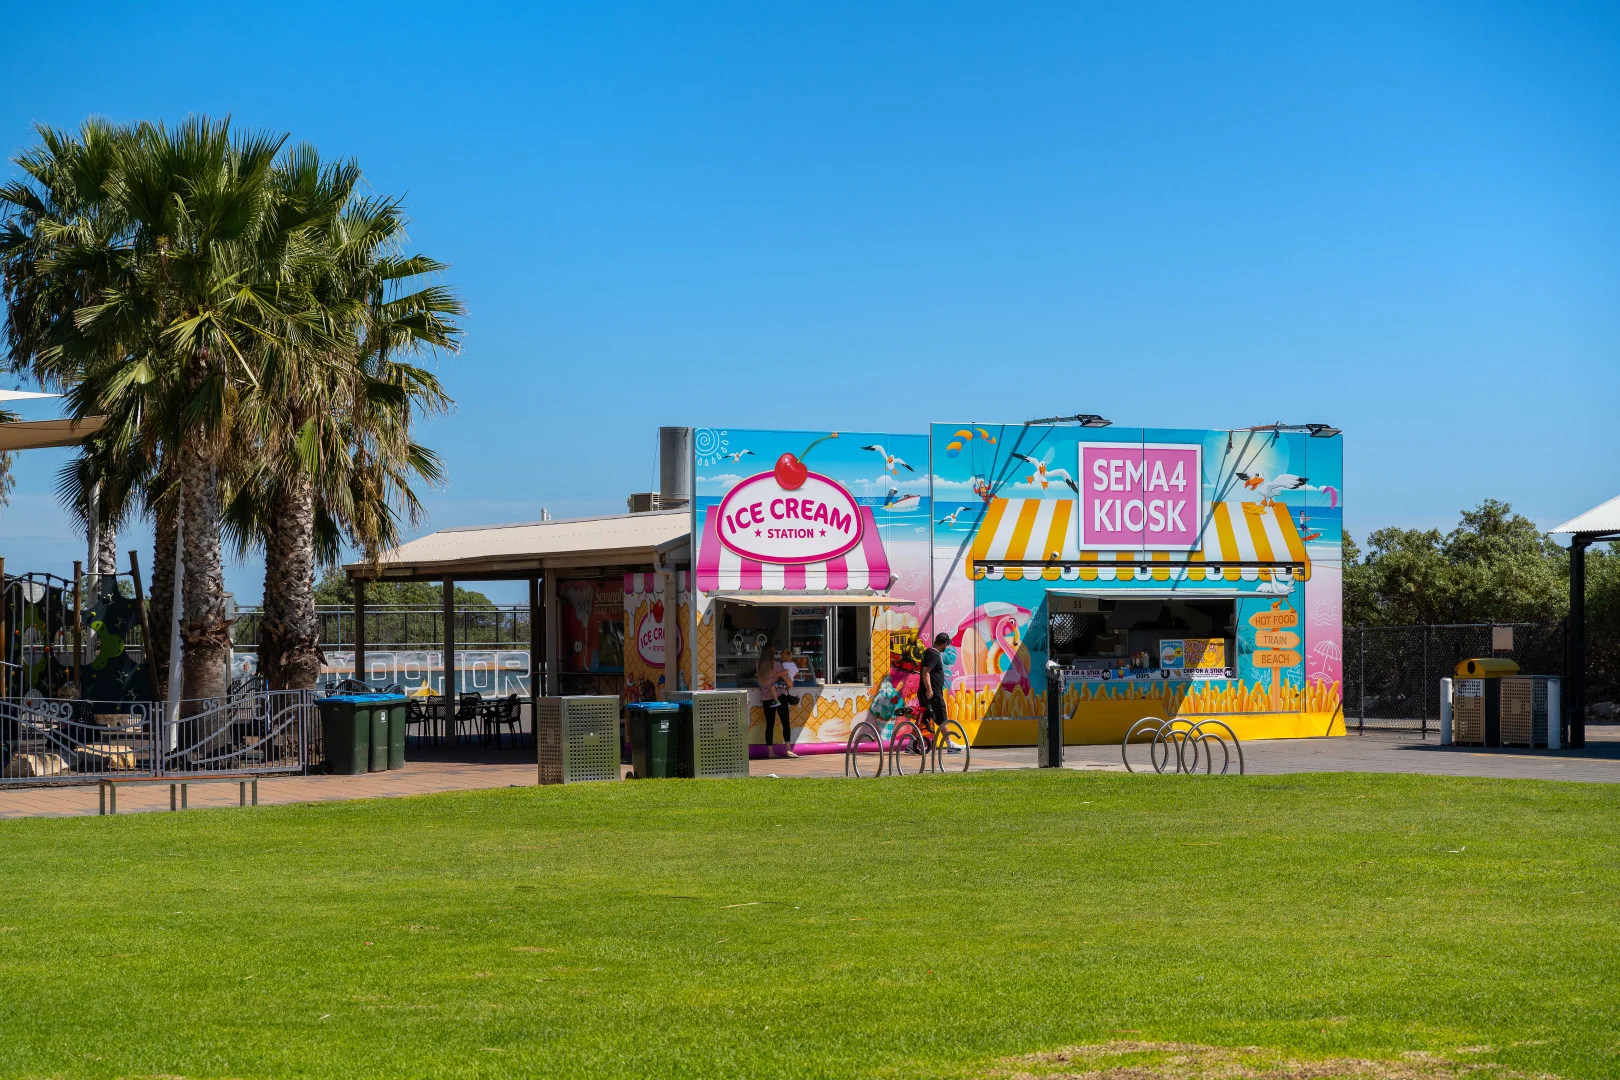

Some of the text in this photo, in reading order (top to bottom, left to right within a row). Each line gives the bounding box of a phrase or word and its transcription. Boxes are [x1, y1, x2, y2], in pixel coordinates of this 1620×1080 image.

[1093, 459, 1187, 492] SEMA4
[726, 497, 851, 535] ICE CREAM
[1094, 499, 1187, 532] KIOSK
[767, 528, 814, 539] STATION
[1255, 614, 1296, 626] HOT FOOD
[640, 630, 652, 649] ICE
[1263, 635, 1287, 645] TRAIN
[1261, 654, 1290, 664] BEACH
